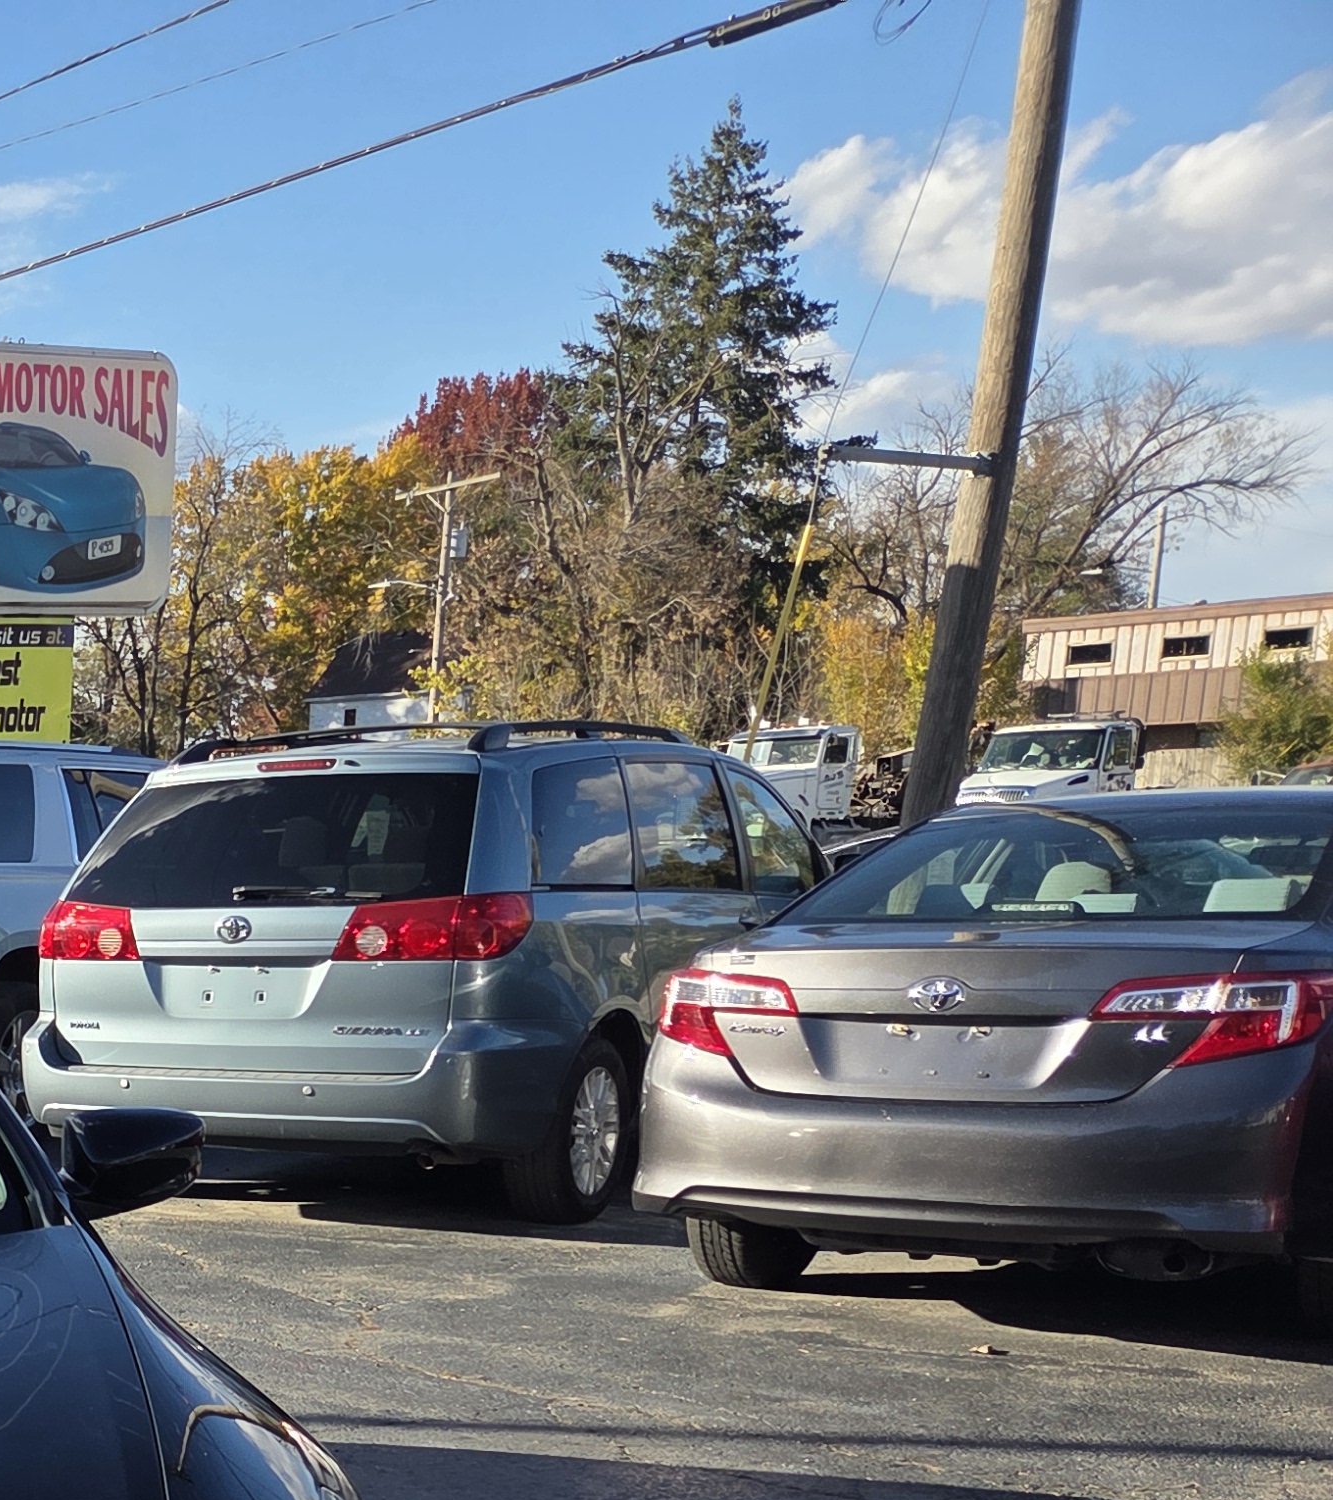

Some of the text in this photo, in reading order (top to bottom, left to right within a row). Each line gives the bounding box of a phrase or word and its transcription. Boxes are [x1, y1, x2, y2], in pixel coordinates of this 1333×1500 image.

[93, 366, 170, 458] SALES
[18, 629, 41, 645] us
[45, 627, 66, 645] at:
